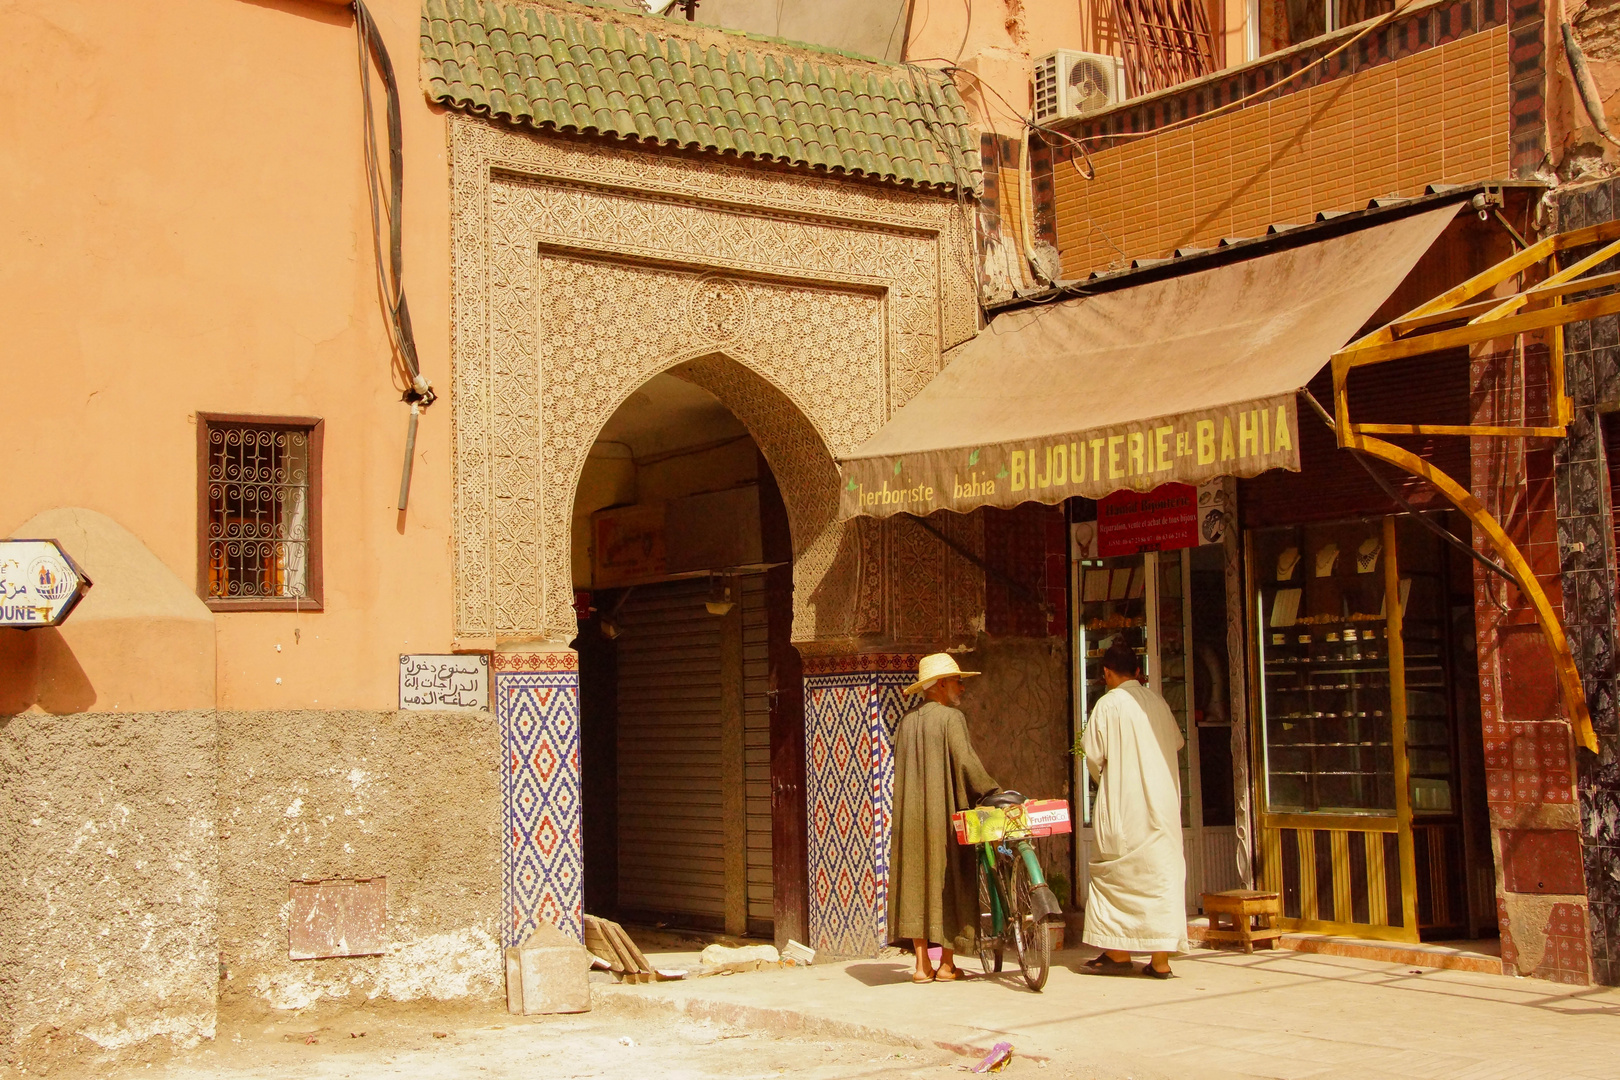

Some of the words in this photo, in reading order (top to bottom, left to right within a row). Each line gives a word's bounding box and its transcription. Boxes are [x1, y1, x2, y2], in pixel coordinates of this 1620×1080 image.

[1011, 425, 1174, 491] BIJOUTERIE
[1176, 432, 1193, 457] EL
[1196, 405, 1293, 466] BAHIA
[858, 478, 934, 507] herboriste
[953, 471, 996, 499] bahia
[1106, 502, 1137, 516] Hamid
[1141, 496, 1190, 513] Bijouterie
[1147, 518, 1160, 527] achat
[1162, 517, 1168, 525] de
[1180, 514, 1196, 524] bijoux
[406, 660, 437, 676] دخول
[438, 664, 479, 680] ممنوع
[420, 673, 479, 697] الدراجات
[438, 691, 478, 708] صاغة
